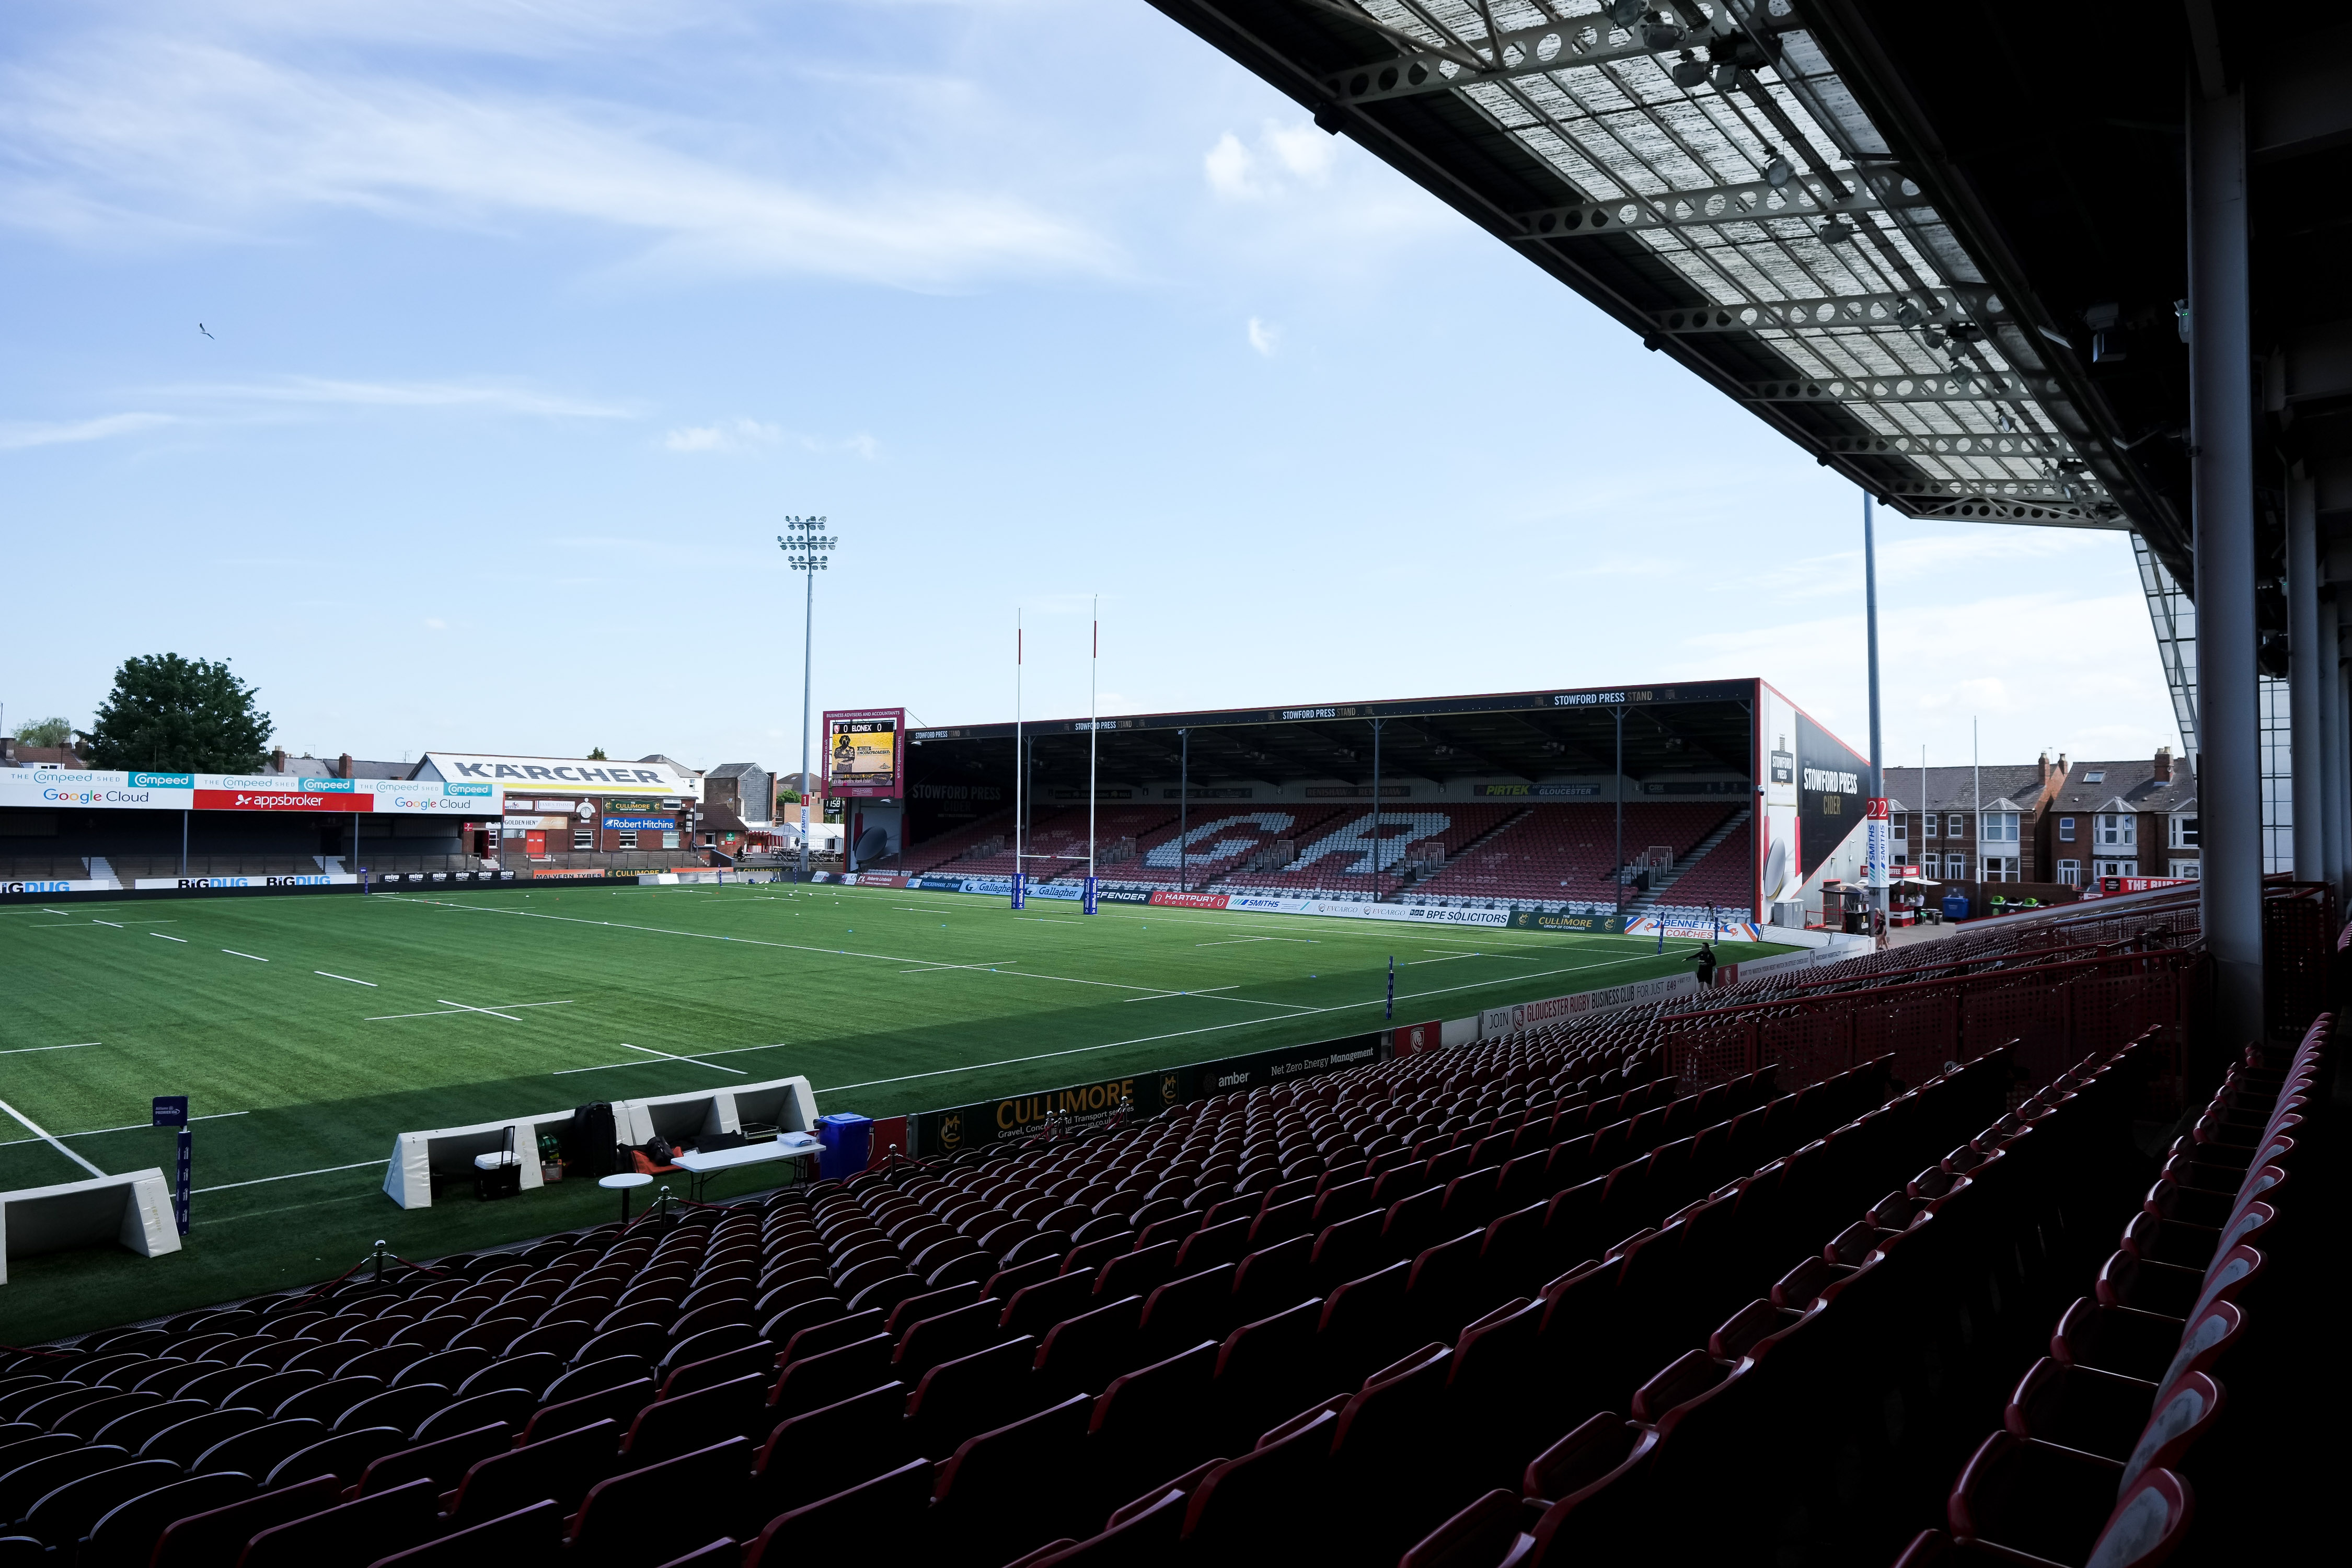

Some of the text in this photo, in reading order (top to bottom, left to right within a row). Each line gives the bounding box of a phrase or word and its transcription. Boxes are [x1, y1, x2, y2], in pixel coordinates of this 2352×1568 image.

[1554, 691, 1652, 706] STOWFORD PRESS STAND
[1283, 707, 1356, 719] STOWFORD PRESS STAND
[877, 723, 882, 732] 0
[1772, 756, 1792, 769] STOWFORD
[33, 771, 92, 783] Compeed
[454, 762, 665, 783] KÄRCHER
[1778, 769, 1788, 779] PRESS
[134, 773, 189, 787] Compeed
[223, 777, 272, 789] Compeed
[304, 779, 350, 791] Compeed
[1804, 768, 1858, 794] STOWFORD PRESS
[376, 781, 418, 792] Compeed
[448, 783, 488, 795] Compeed
[912, 784, 1001, 800] STOWFORD PRESS
[1486, 785, 1530, 795] PIRTEK
[43, 789, 148, 804] Google Cloud
[254, 794, 323, 808] appsbroker
[803, 796, 807, 805] 1
[395, 797, 470, 810] Google Cloud
[1824, 795, 1841, 815] CIDER
[614, 820, 673, 828] Robert Hitchins
[979, 883, 1012, 893] Gallaghe
[2127, 880, 2147, 891] THE
[1039, 886, 1078, 898] Gallagher
[1165, 894, 1217, 903] HARTPURY
[1426, 910, 1446, 919] BPE
[1447, 912, 1507, 923] SOLICITORS
[1538, 917, 1593, 927] CULLIMORE
[1666, 929, 1713, 939] COACHES
[1489, 1012, 1508, 1029] JOIN
[1527, 998, 1568, 1023] GLOUCESTER
[1570, 994, 1590, 1013] RUGBY
[1592, 987, 1619, 1009] BUSINESS
[1621, 986, 1634, 1003] CLUB
[1637, 984, 1649, 999] FOR
[1651, 982, 1664, 996] JUST
[1666, 980, 1676, 991] £49
[1271, 1047, 1373, 1076] Net Zero Energy Management
[1218, 1071, 1249, 1087] amber
[997, 1079, 1133, 1129] CULLIMORE
[998, 1126, 1024, 1138] Gravel,
[1074, 1112, 1107, 1123] Transport
